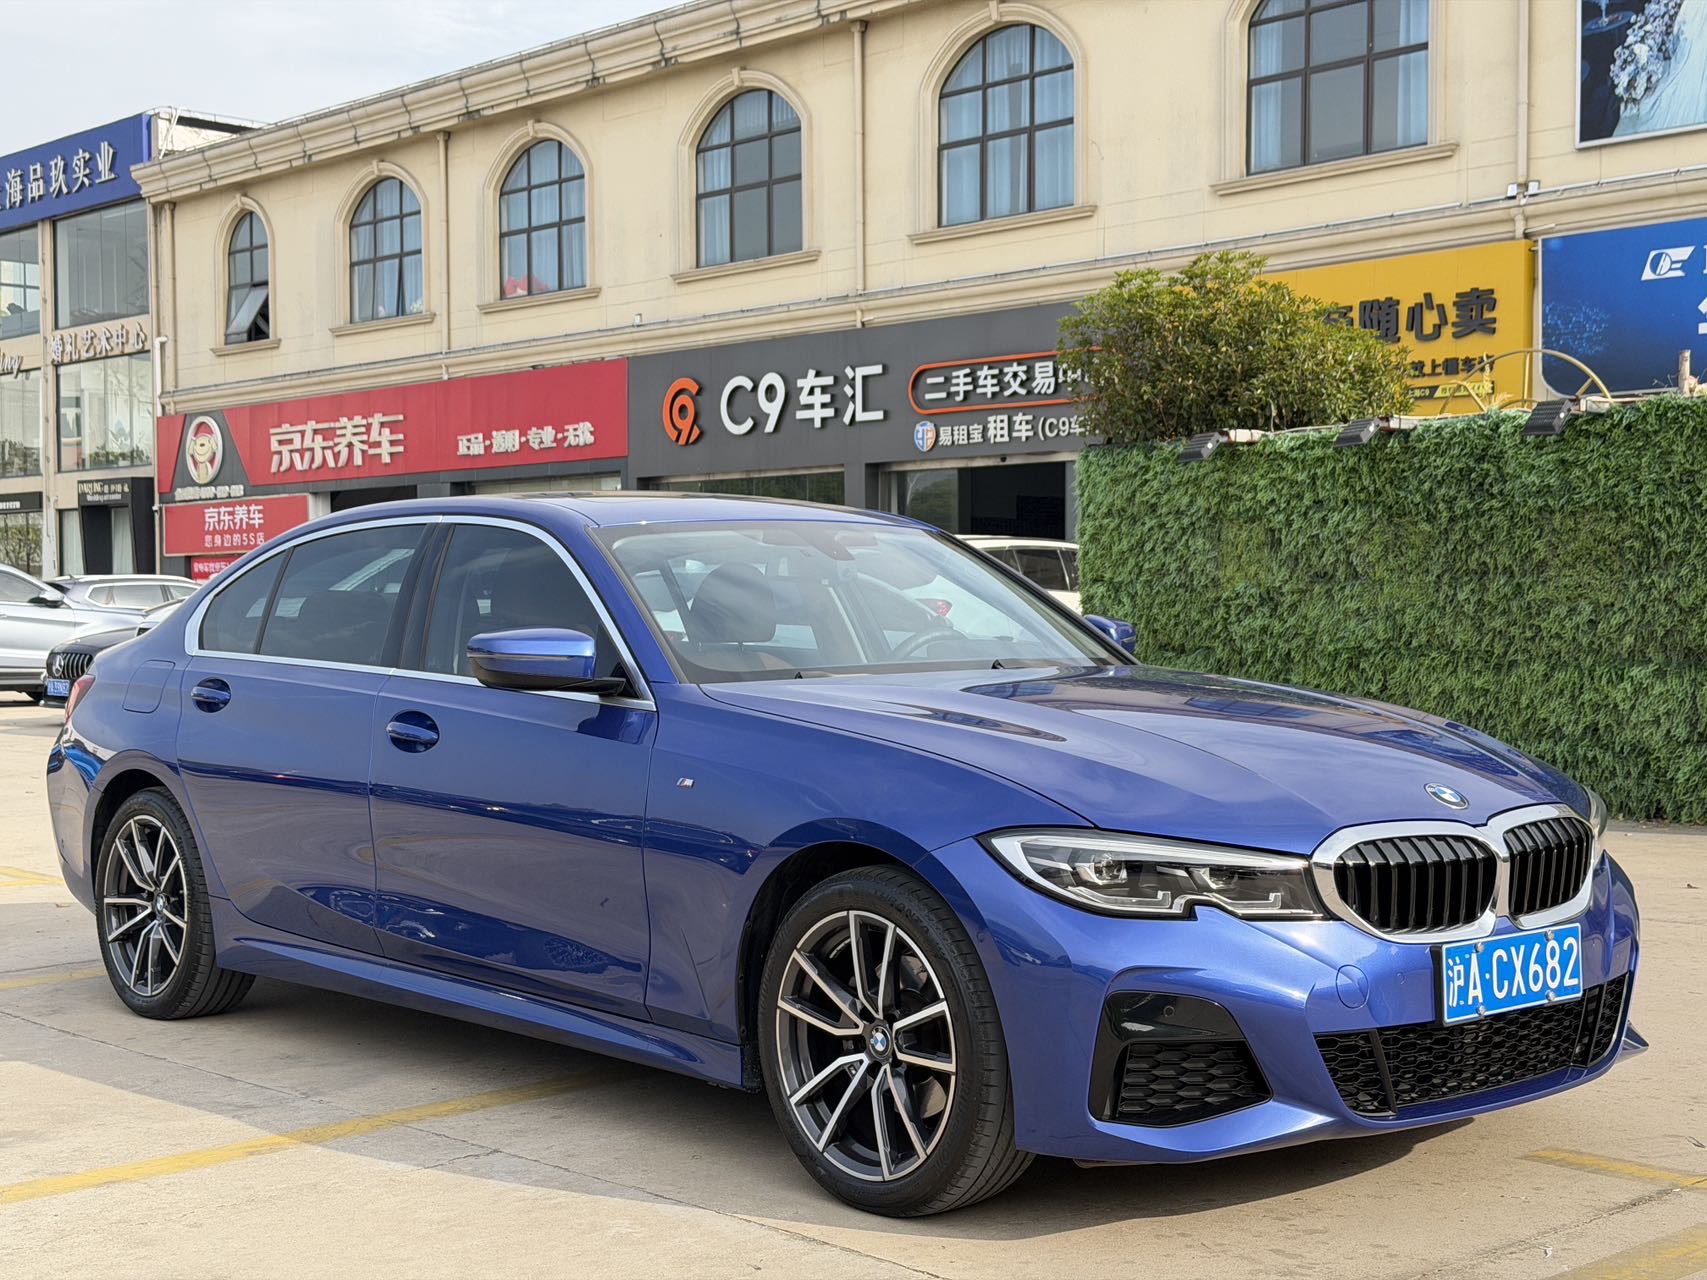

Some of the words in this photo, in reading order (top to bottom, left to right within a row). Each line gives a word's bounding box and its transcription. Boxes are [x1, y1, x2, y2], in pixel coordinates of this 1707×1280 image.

[0, 141, 117, 210] 海品玖实业
[719, 364, 885, 436] C9车汇
[924, 360, 1057, 402] 二手车交易
[269, 412, 405, 474] 京东养车
[203, 503, 265, 532] 京东养车
